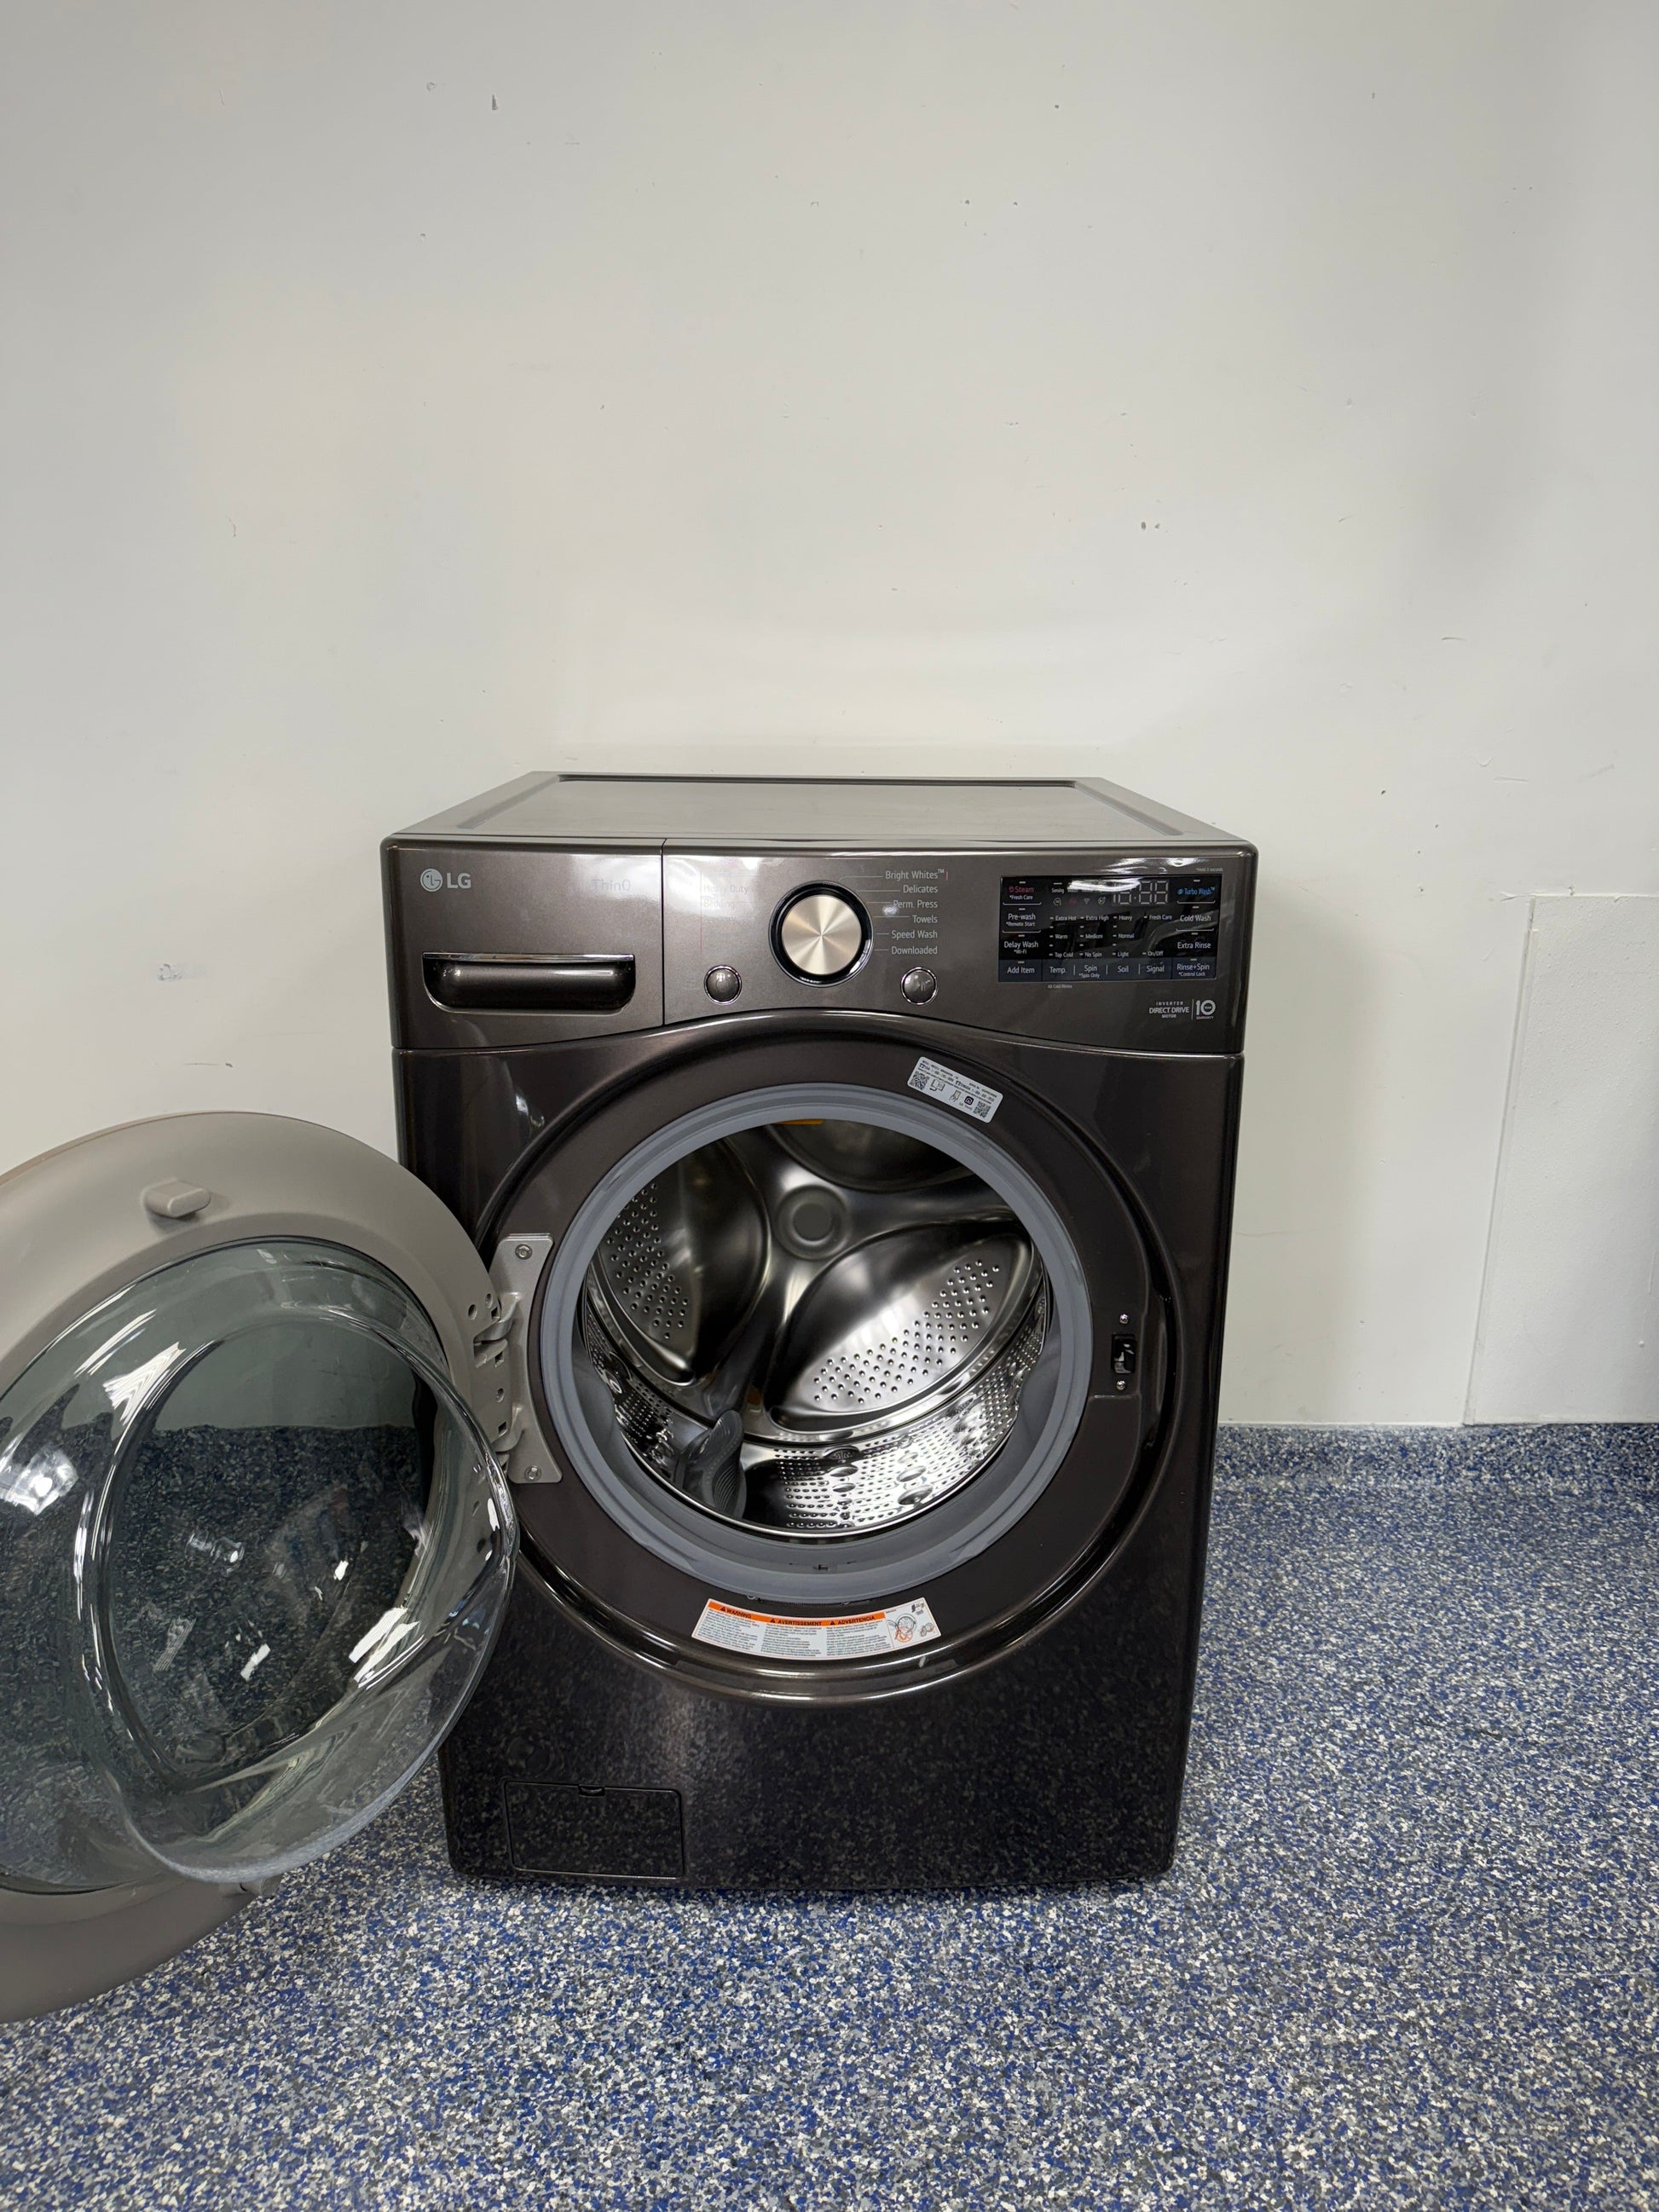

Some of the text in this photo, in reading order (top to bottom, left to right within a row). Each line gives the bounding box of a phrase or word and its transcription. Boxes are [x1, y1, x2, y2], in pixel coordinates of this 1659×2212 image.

[446, 872, 471, 889] LG
[885, 871, 910, 881] Bright
[730, 884, 749, 894] Duty
[903, 884, 939, 893] Delicates
[1015, 885, 1035, 893] Steam
[893, 899, 939, 909] Perm. Press
[912, 915, 939, 924] Towels
[891, 930, 938, 940] Speed Wash
[891, 945, 938, 955] Downloaded
[1003, 941, 1021, 950] Delay
[1084, 964, 1098, 973] Spin
[1147, 964, 1165, 973] Signal
[1195, 999, 1216, 1016] 10
[726, 1608, 752, 1619] WARNING
[837, 1616, 875, 1625] ADVERTENCIA
